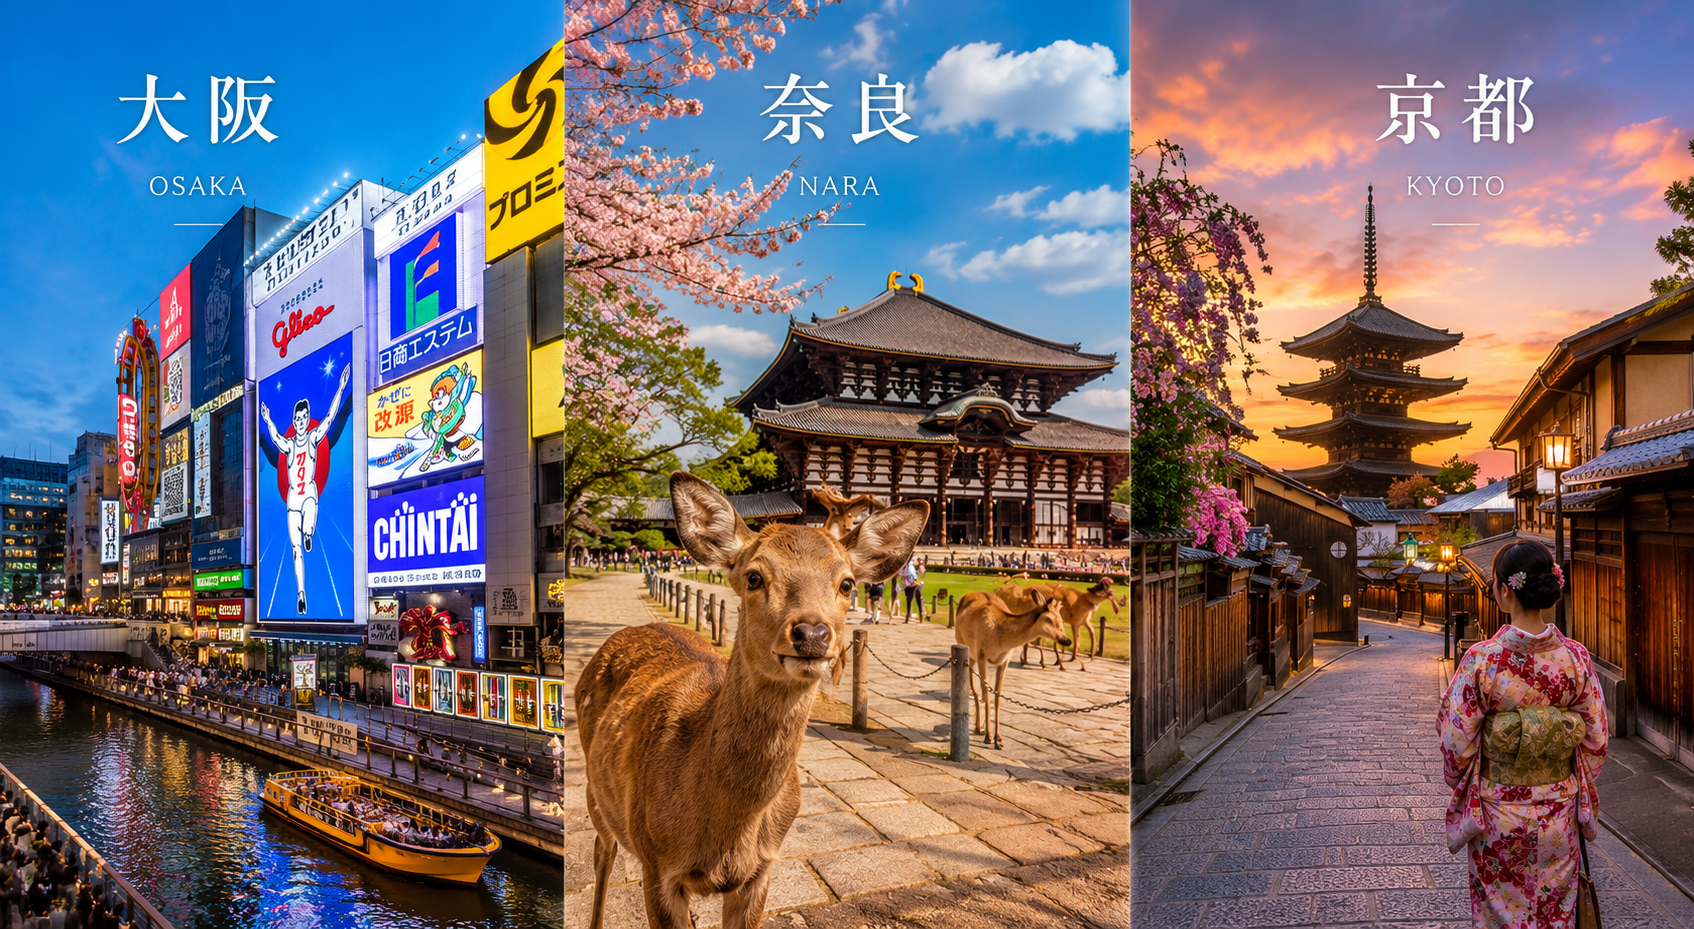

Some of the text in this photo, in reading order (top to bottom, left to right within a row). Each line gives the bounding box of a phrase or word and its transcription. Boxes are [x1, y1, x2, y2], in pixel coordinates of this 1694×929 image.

[489, 160, 564, 231] プロミ
[380, 315, 473, 374] 日商エステム
[374, 399, 415, 432] 改源
